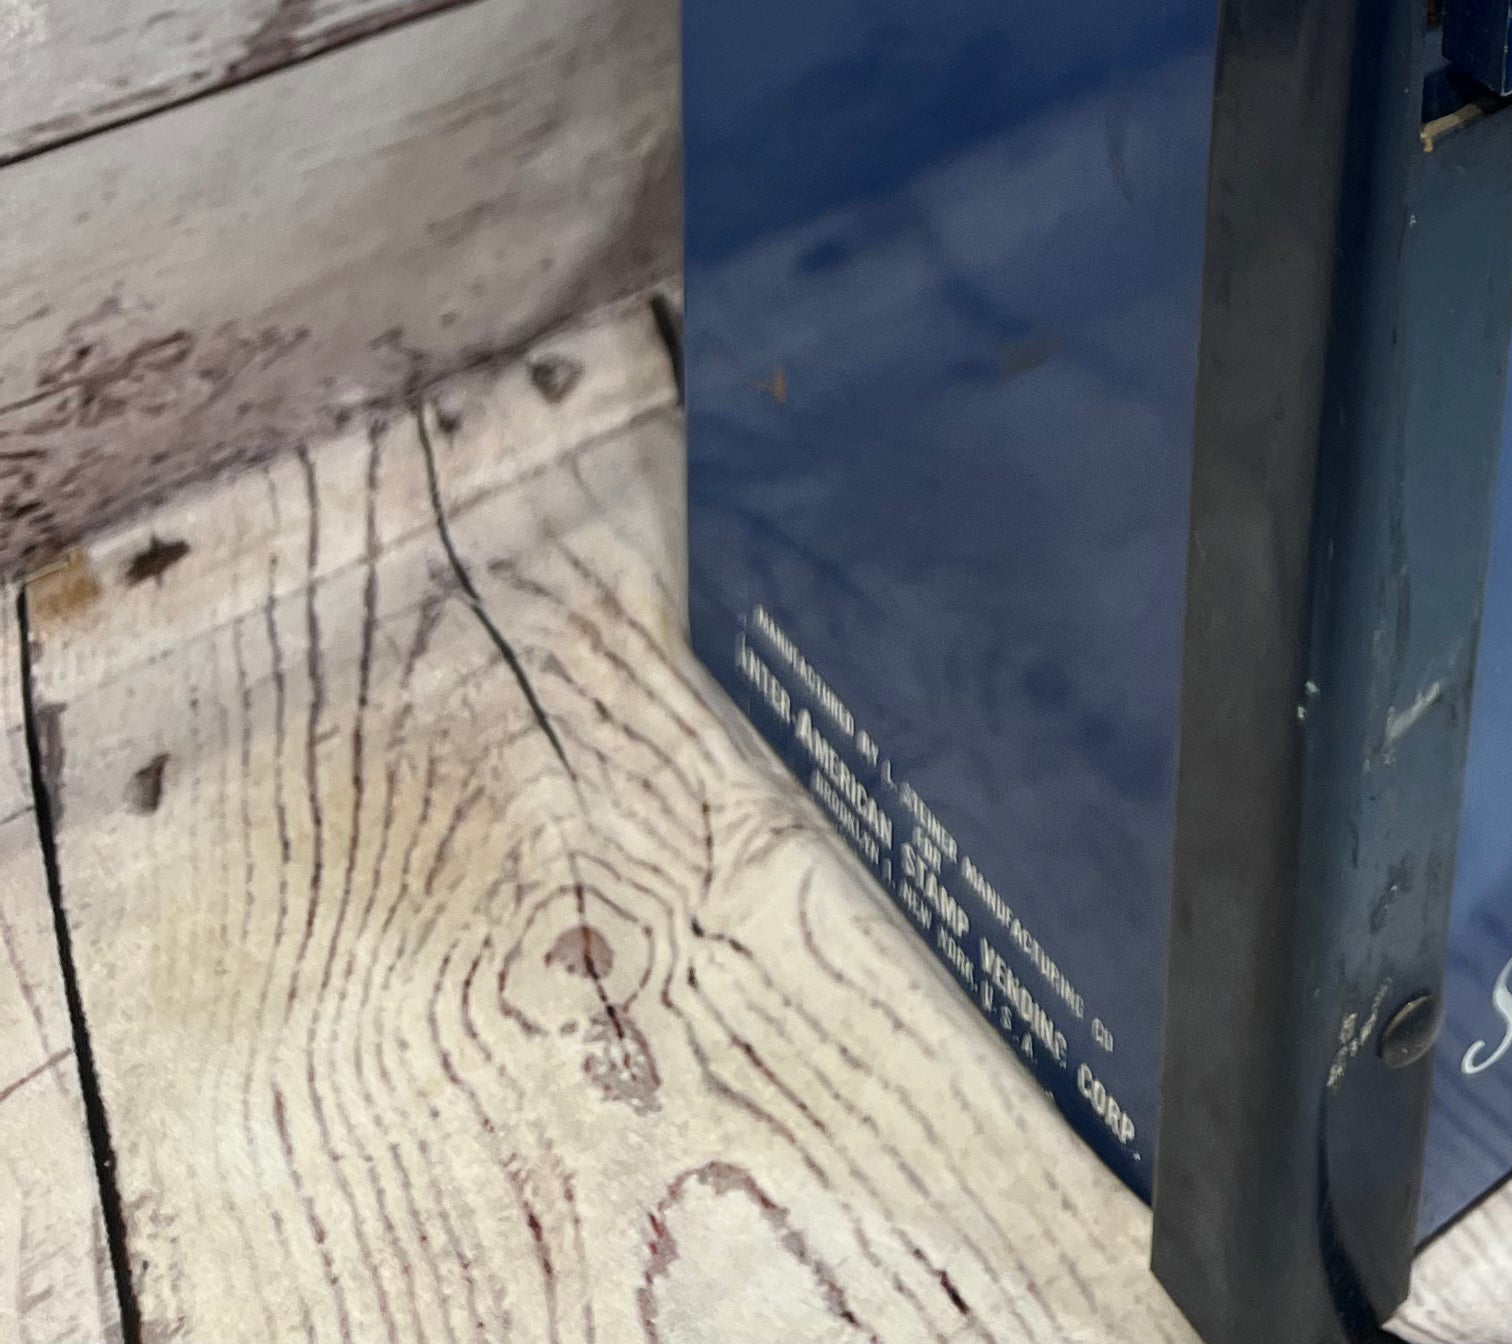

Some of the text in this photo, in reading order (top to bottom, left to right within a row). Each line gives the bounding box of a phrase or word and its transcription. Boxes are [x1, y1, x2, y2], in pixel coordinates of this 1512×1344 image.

[900, 880, 933, 931] NEW
[900, 841, 971, 939] STAMP
[979, 936, 1069, 1067] VENDING
[960, 855, 1085, 1019] MANUFACTURING
